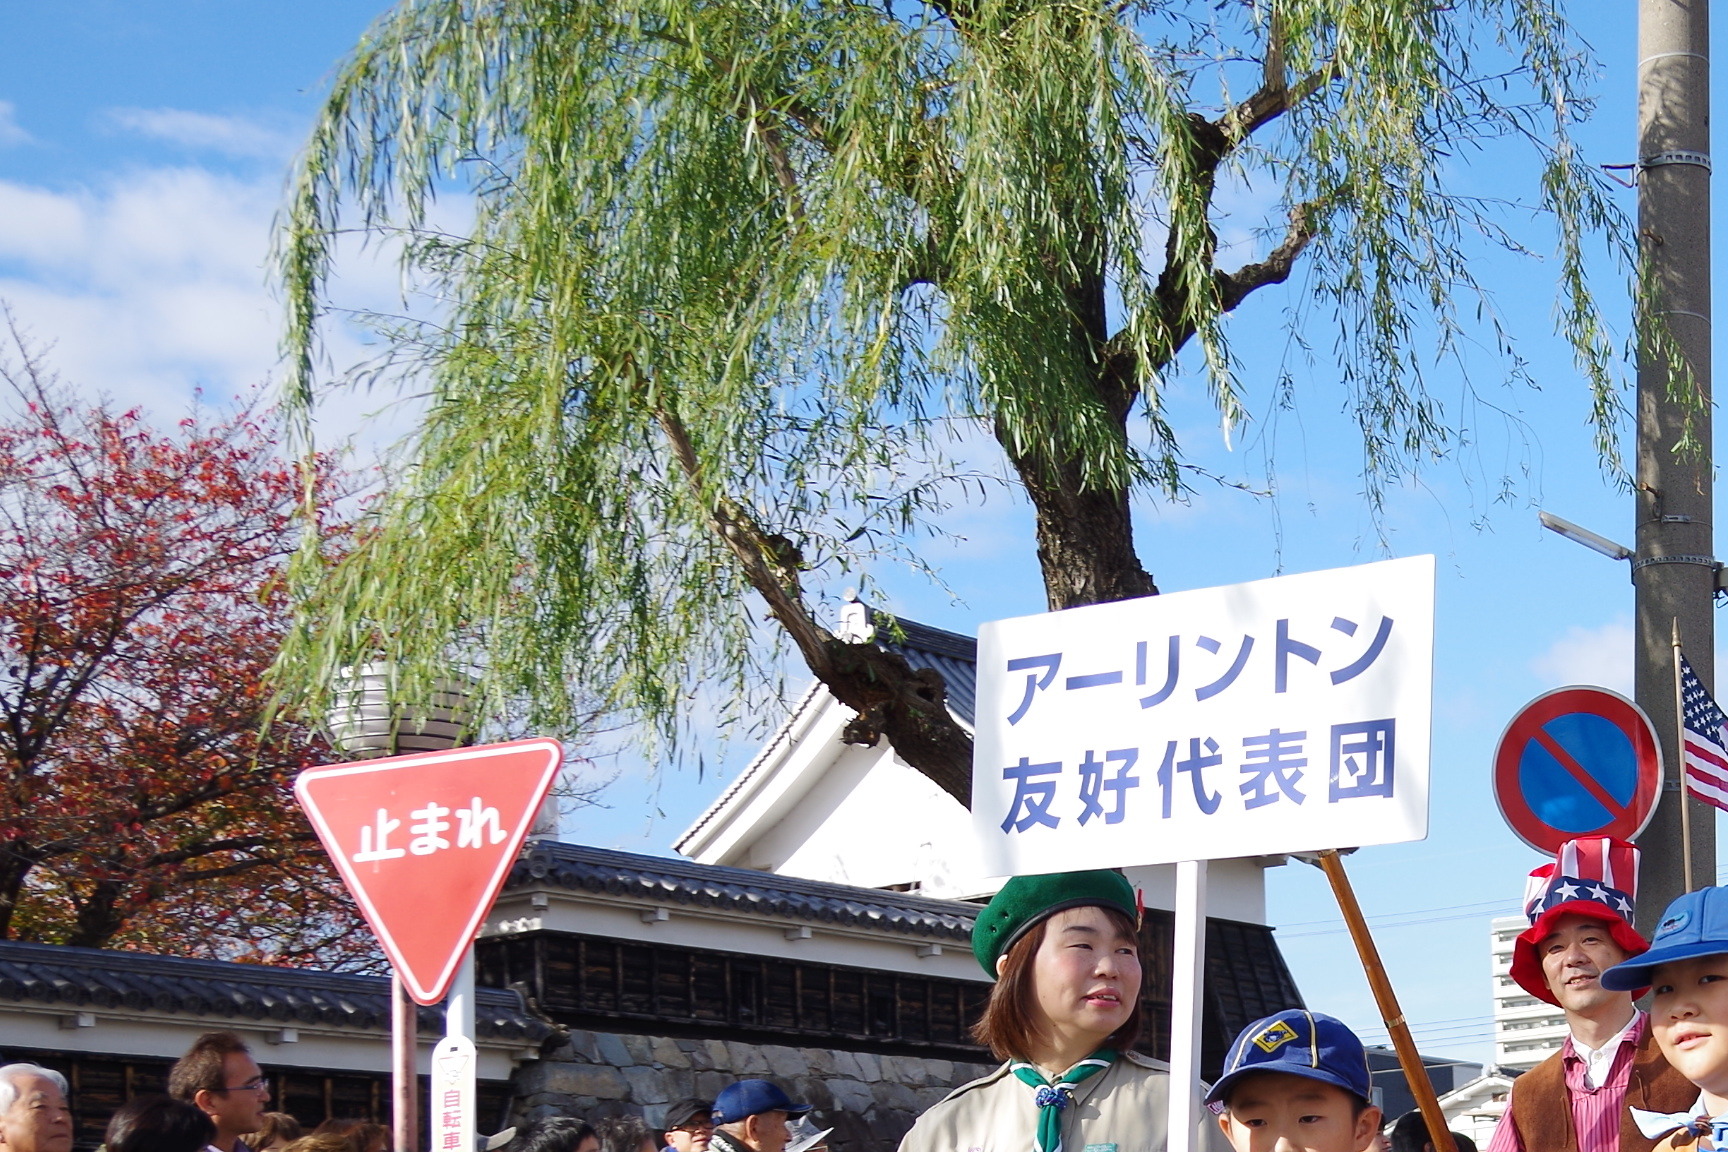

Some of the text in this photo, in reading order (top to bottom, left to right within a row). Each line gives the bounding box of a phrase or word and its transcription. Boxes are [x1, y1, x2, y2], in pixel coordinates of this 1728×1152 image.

[1006, 614, 1395, 727] アーリントン
[352, 796, 508, 865] 止まれ
[1000, 717, 1396, 835] 友好代表団
